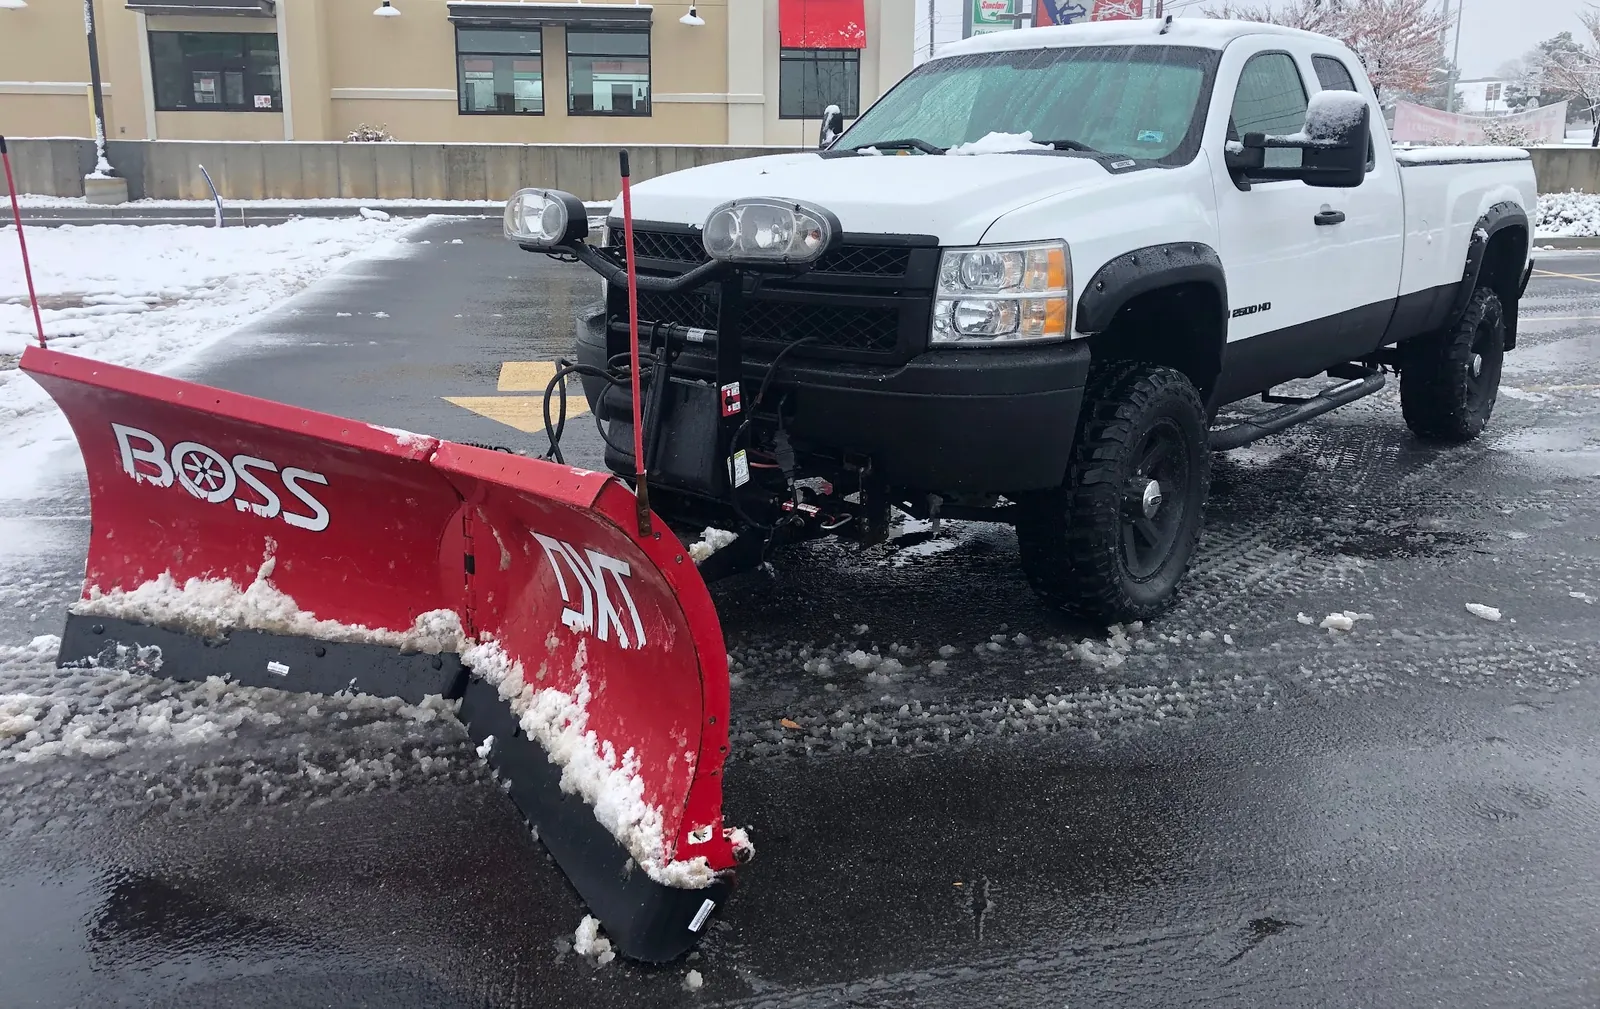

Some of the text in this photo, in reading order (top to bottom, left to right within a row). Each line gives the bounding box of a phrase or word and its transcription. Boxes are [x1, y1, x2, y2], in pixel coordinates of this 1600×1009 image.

[981, 1, 1007, 10] Sinclair
[1232, 304, 1257, 318] 2500
[1258, 301, 1272, 312] HD
[111, 422, 330, 532] BOSS
